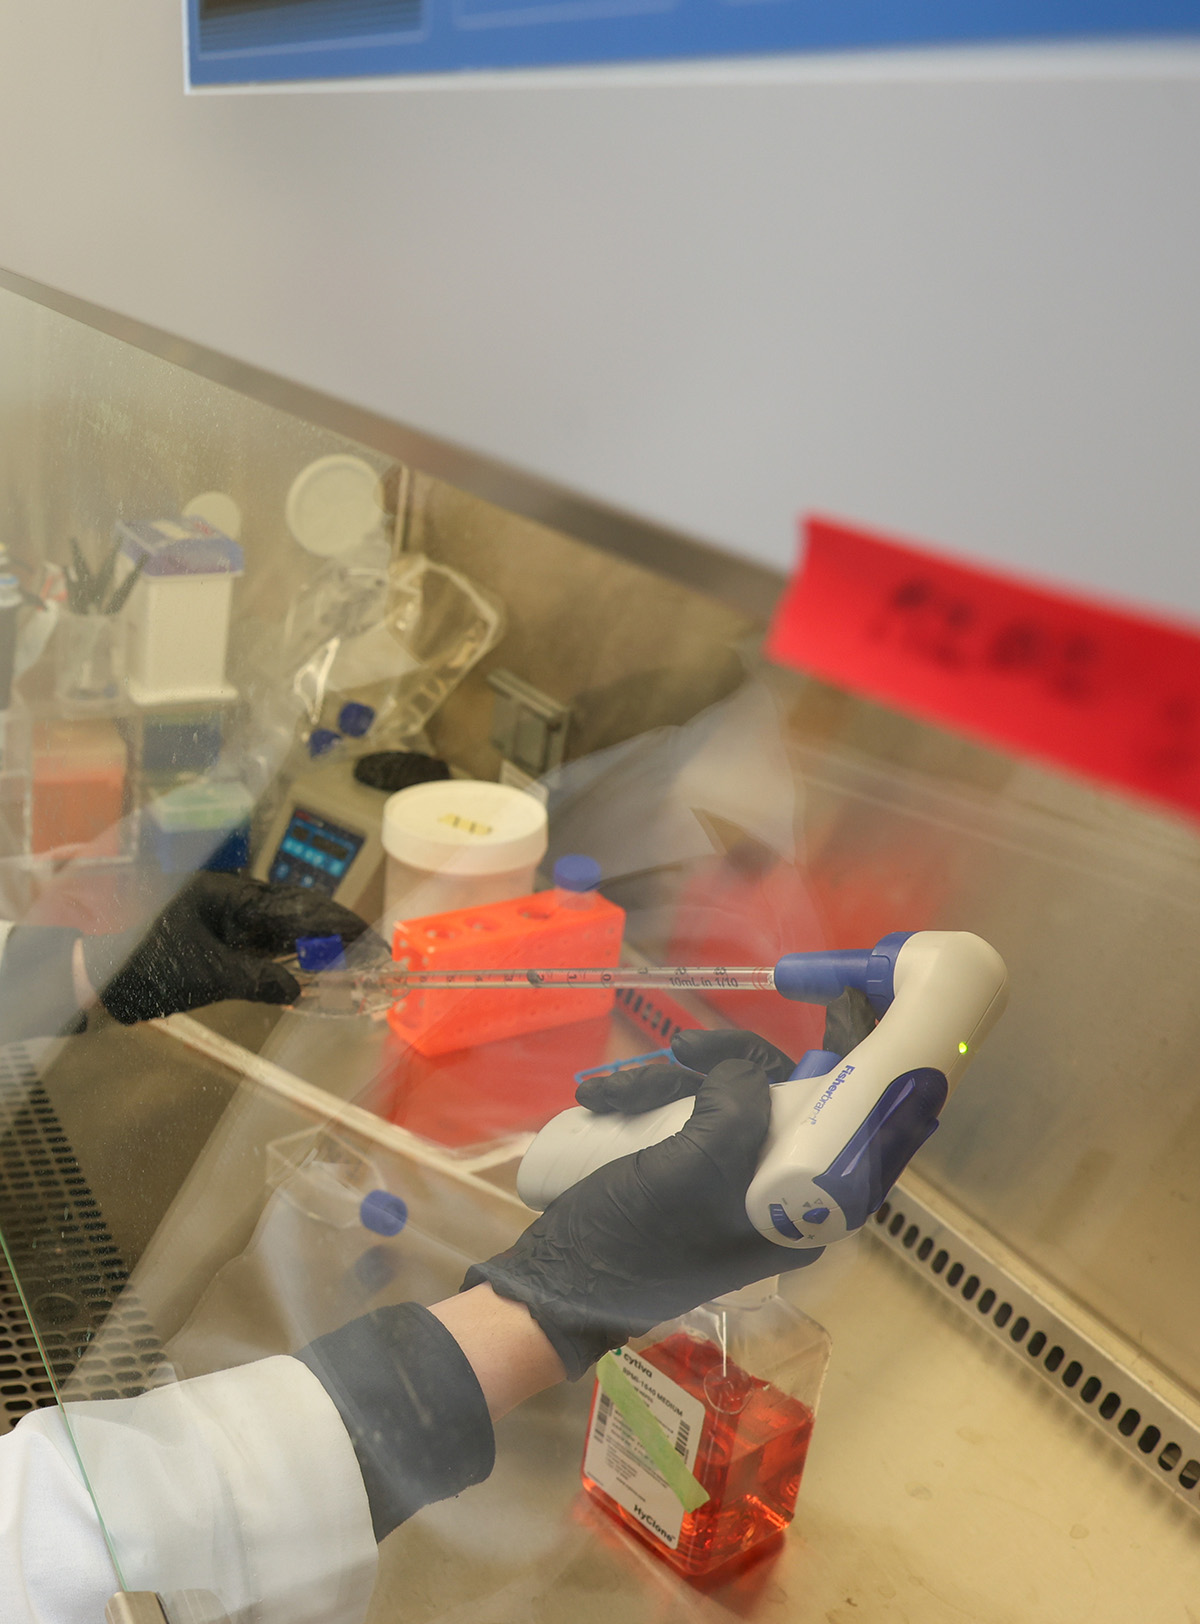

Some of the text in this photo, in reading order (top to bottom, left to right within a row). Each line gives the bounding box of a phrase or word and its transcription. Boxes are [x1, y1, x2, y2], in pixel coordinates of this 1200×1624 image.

[603, 971, 612, 982] 0
[668, 976, 739, 988] 10mL in 1/10
[623, 1353, 653, 1378] cytiva
[656, 1392, 684, 1417] MEDIUM
